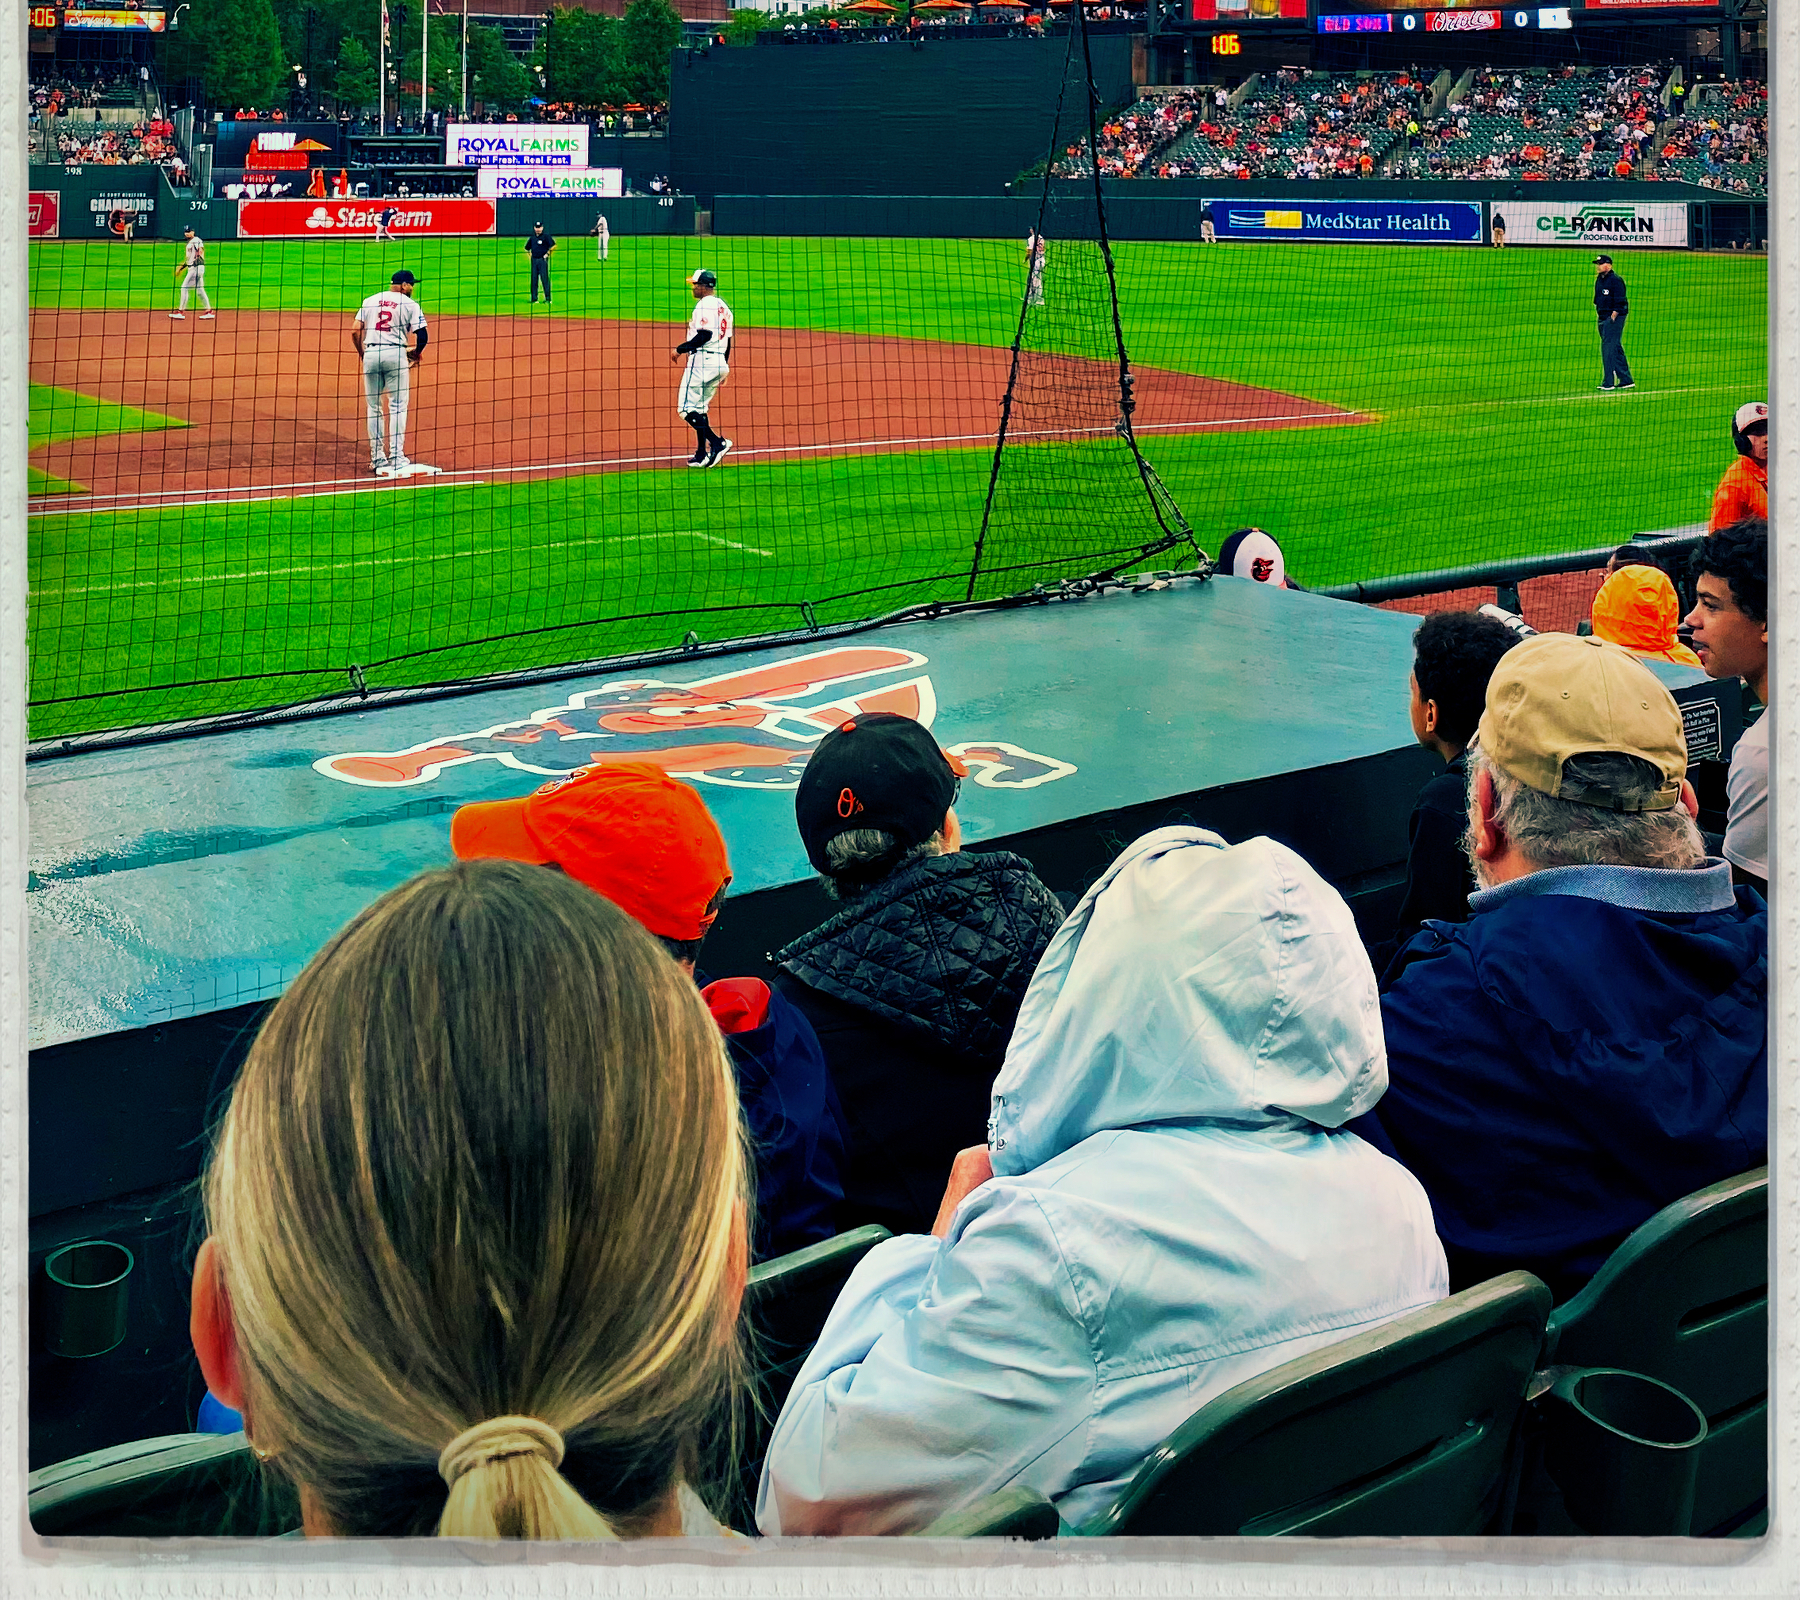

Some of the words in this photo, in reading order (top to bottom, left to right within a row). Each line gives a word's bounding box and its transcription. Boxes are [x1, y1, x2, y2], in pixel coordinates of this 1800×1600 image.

[1403, 14, 1416, 31] 0
[1431, 10, 1495, 32] Orioles
[1514, 11, 1528, 27] 0
[1211, 34, 1240, 55] 1:06
[458, 138, 519, 152] ROYAL
[520, 138, 579, 152] FARMS
[523, 155, 543, 164] Real
[546, 155, 569, 164] Fast.
[64, 167, 82, 176] 398
[496, 177, 552, 189] ROYAL
[552, 177, 604, 189] FARMS
[90, 198, 155, 212] CHAMPIONS
[190, 201, 208, 211] 376
[657, 197, 674, 207] 410
[1306, 212, 1382, 230] MedStar
[1387, 214, 1451, 230] Health
[1619, 234, 1654, 242] EXPERTS
[375, 310, 392, 332] 2
[837, 787, 864, 818] O's
